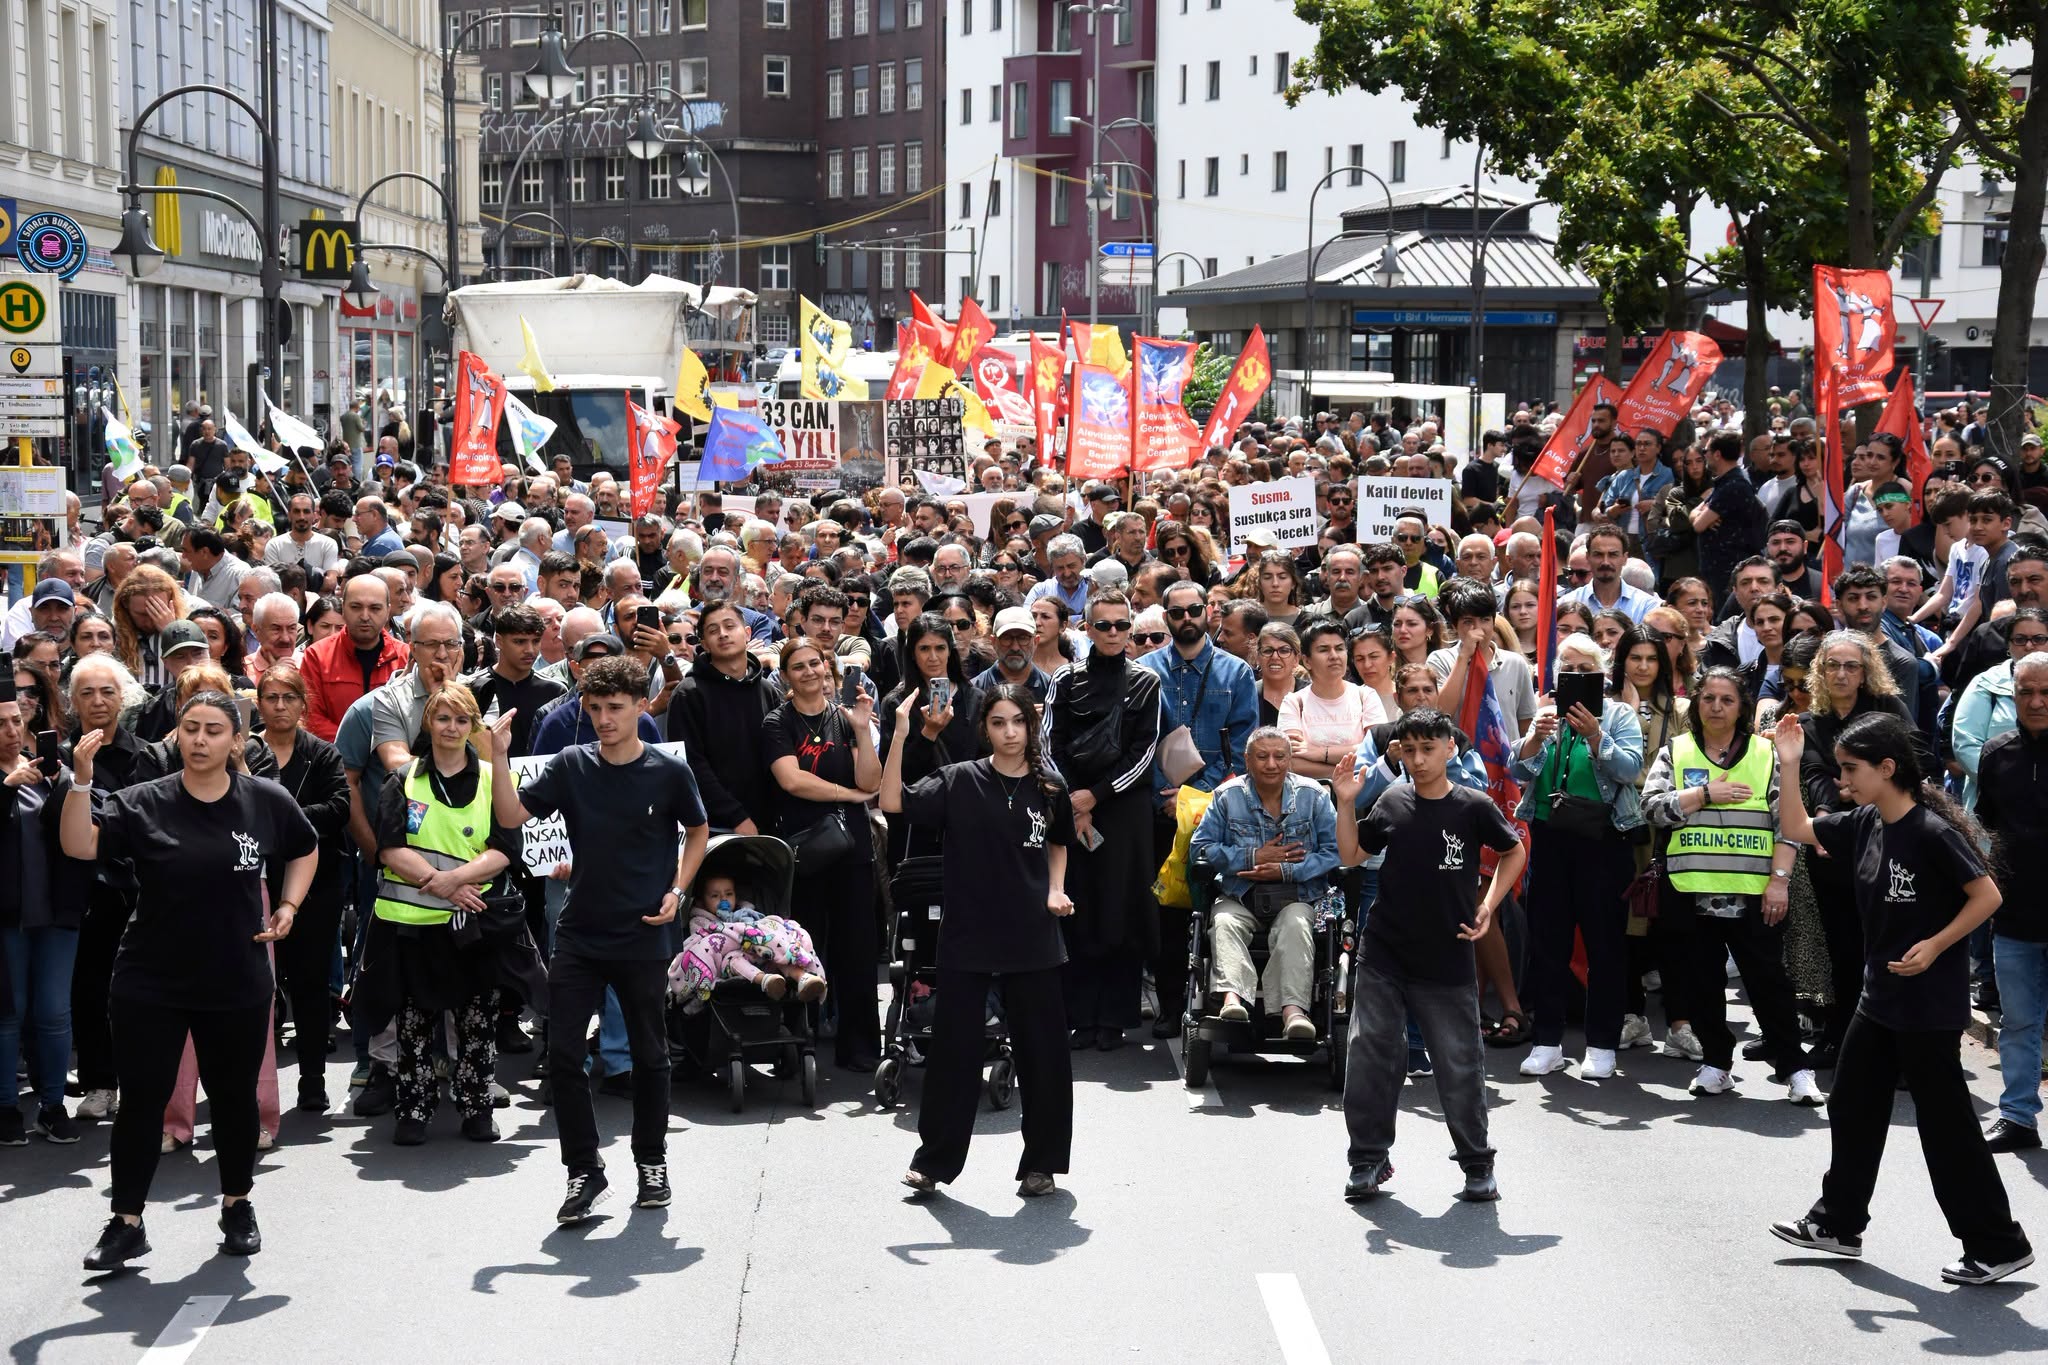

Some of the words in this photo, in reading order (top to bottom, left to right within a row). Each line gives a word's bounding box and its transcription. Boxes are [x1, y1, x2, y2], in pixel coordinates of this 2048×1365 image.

[22, 216, 50, 237] SMACK
[51, 216, 80, 240] BURGER
[5, 293, 32, 322] H
[17, 353, 25, 363] 8
[762, 402, 786, 428] 33
[791, 402, 834, 431] CAN,
[793, 431, 836, 460] YIL!
[1251, 490, 1293, 505] Susma,
[1366, 484, 1398, 499] Katil
[1400, 486, 1444, 501] devlet
[1234, 509, 1286, 526] sustukça
[1289, 506, 1312, 519] sıra
[1273, 524, 1314, 541] elecek!
[1680, 832, 1768, 851] BERLIN-CEMEVI
[525, 846, 568, 867] SANA
